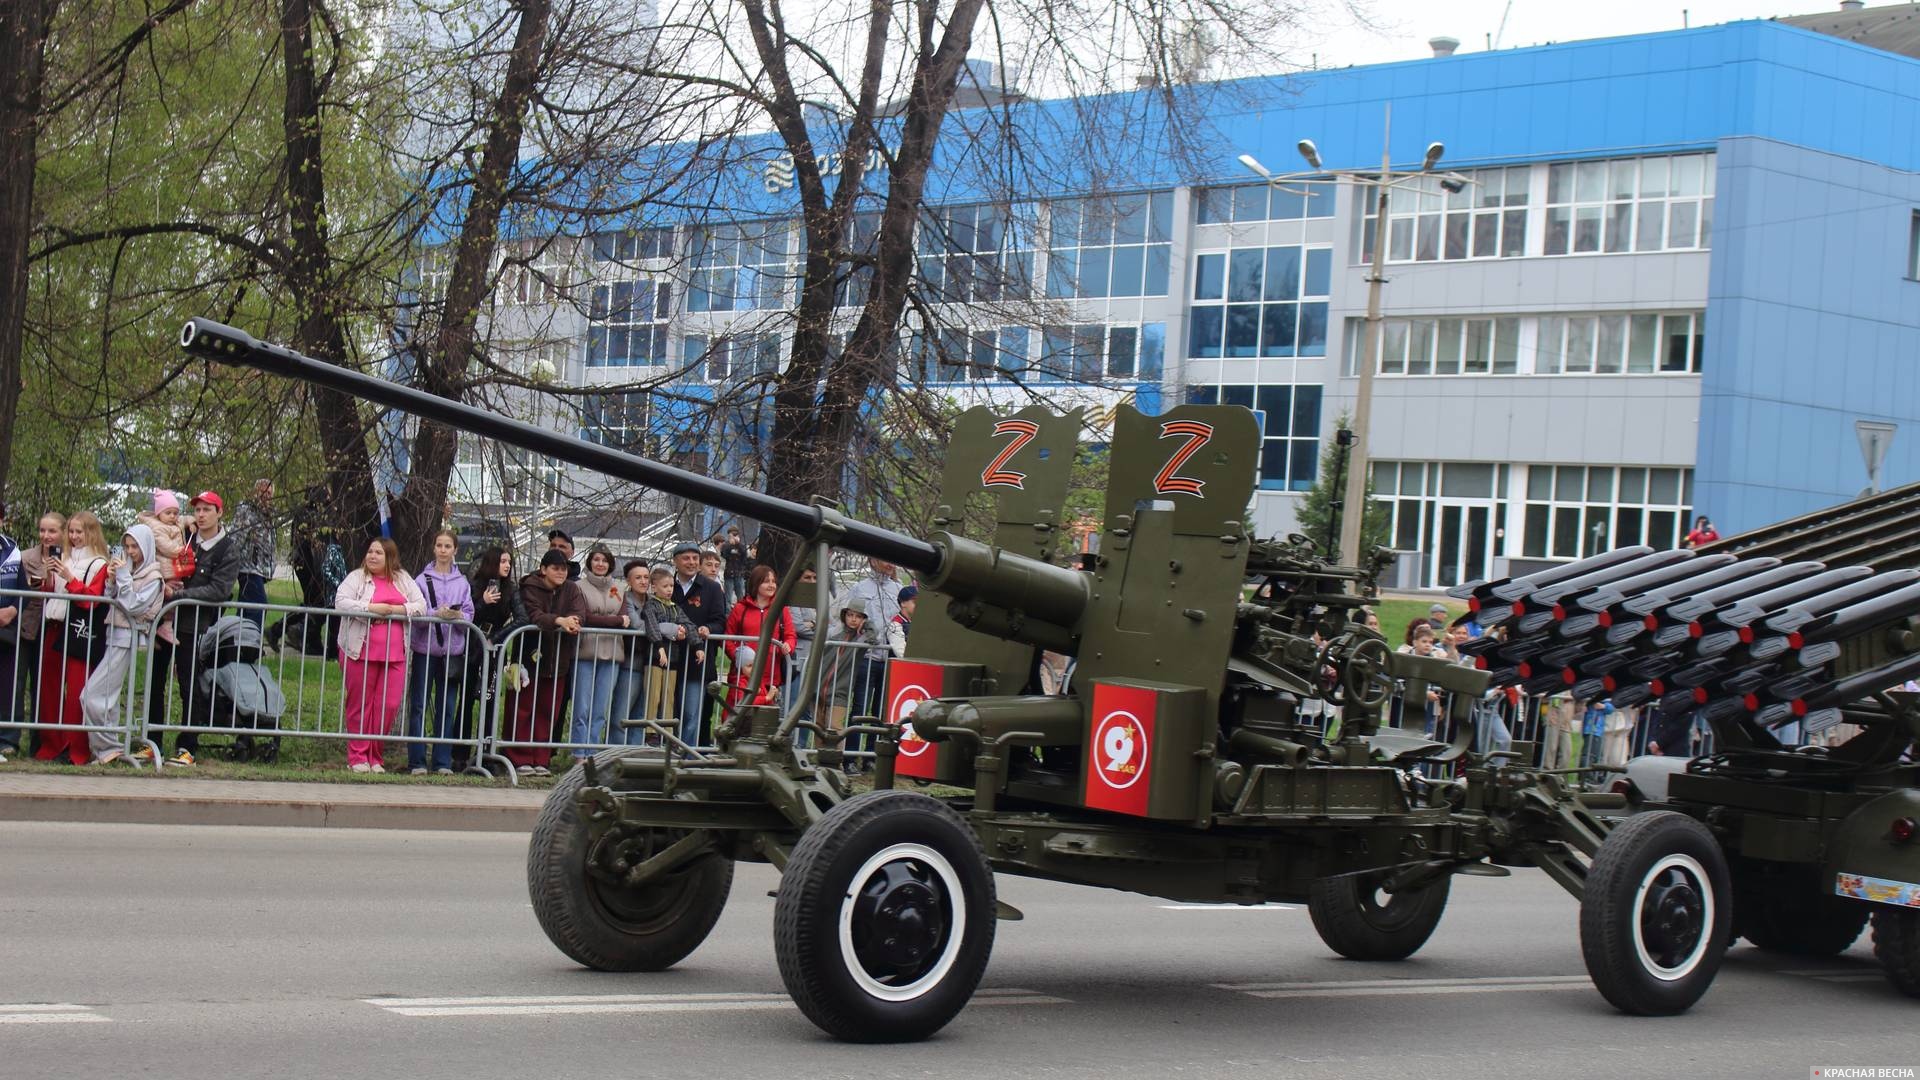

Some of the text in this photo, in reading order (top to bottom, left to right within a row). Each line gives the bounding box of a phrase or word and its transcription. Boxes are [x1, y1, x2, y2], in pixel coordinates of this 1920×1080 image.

[981, 419, 1040, 490] Z
[1153, 419, 1214, 498] Z
[1104, 726, 1134, 772] 9
